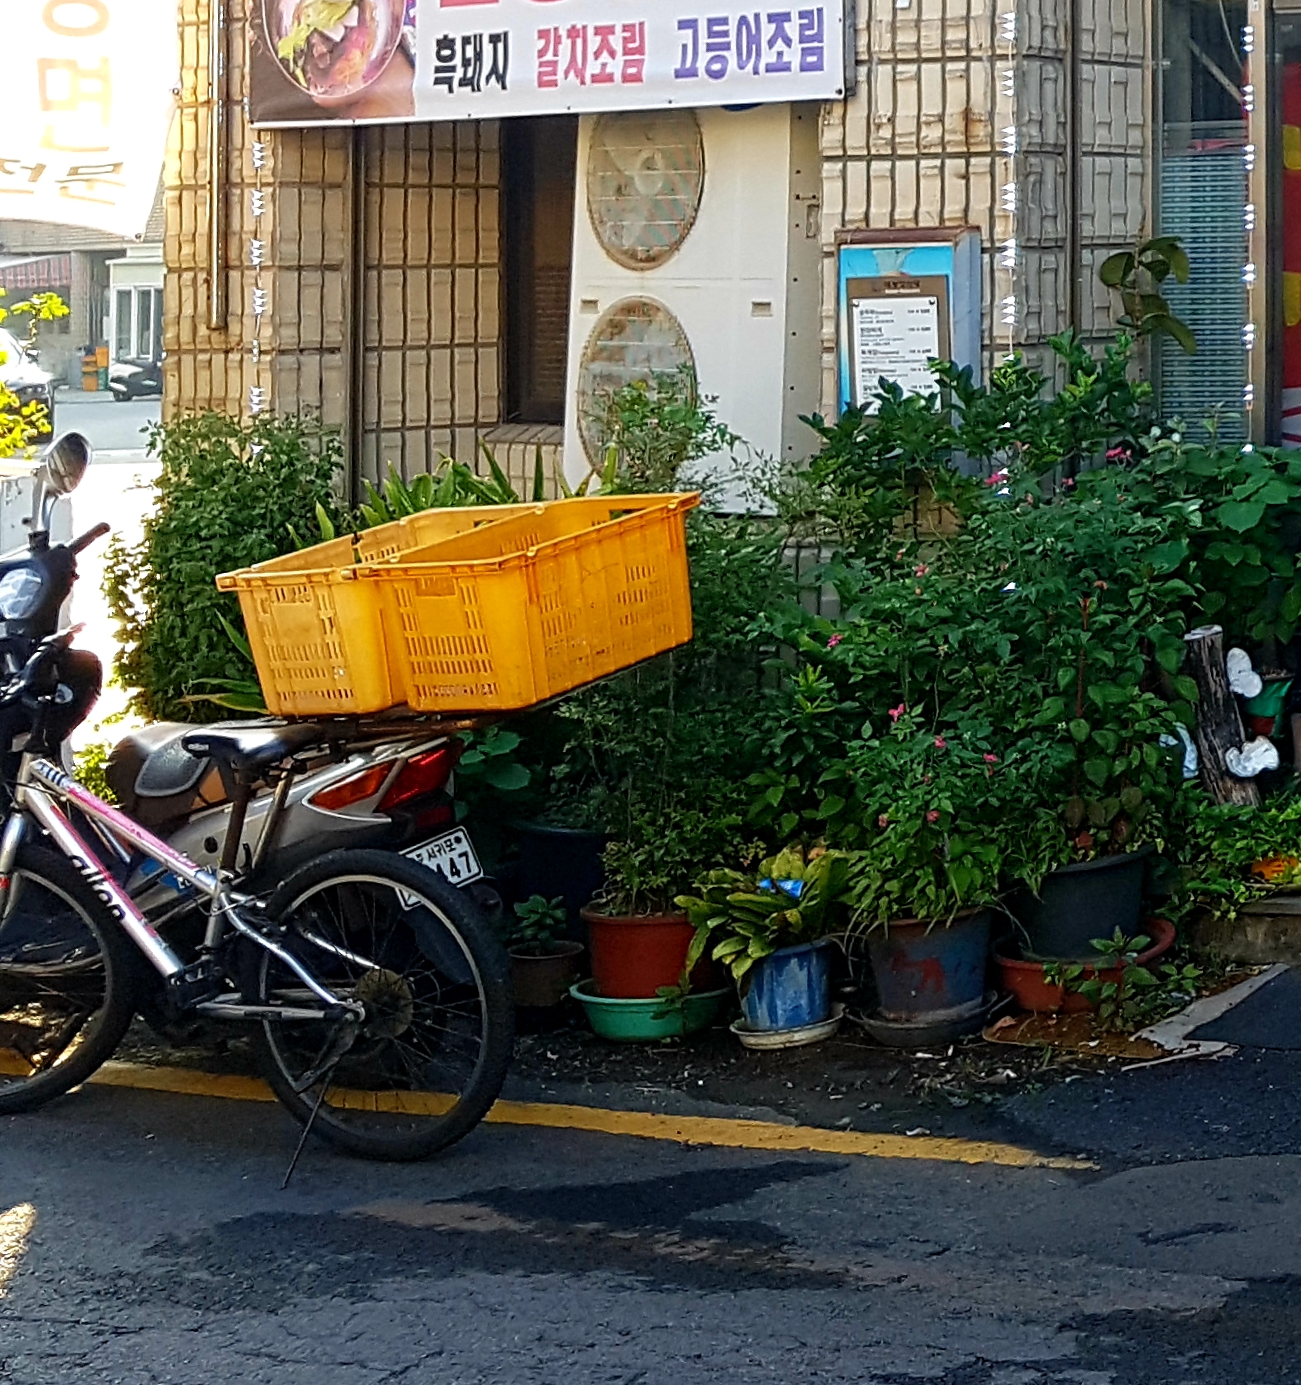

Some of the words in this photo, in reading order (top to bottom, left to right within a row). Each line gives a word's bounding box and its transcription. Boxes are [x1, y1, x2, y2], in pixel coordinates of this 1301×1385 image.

[432, 30, 510, 94] 흑돼지
[536, 21, 646, 90] 갈치조림
[674, 6, 825, 81] 고등어조림
